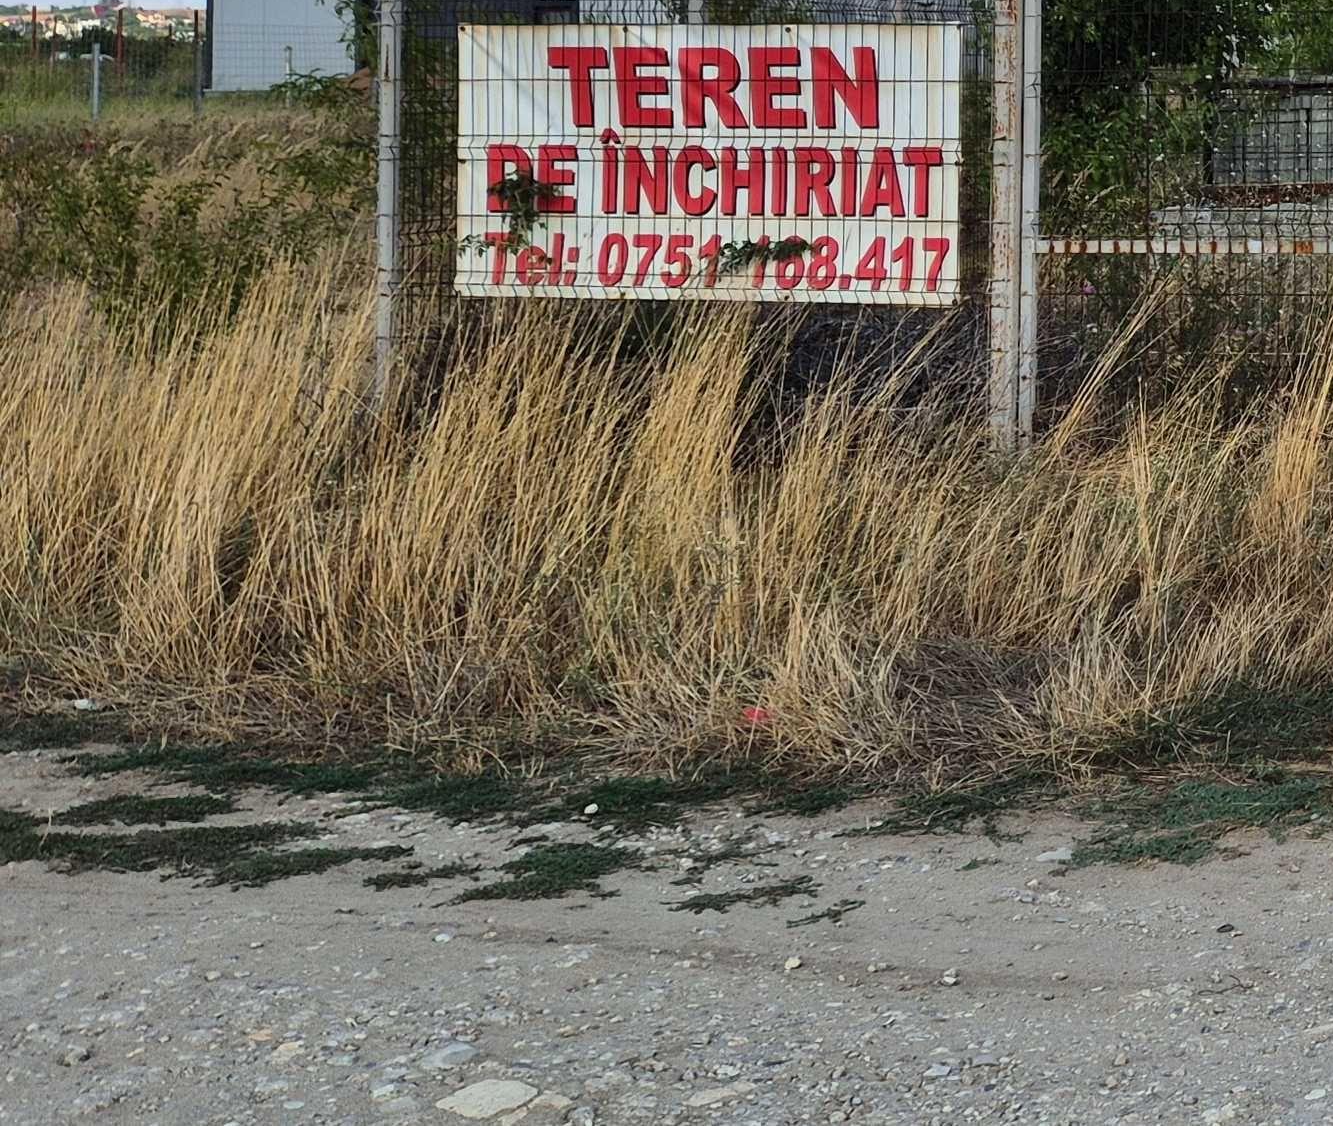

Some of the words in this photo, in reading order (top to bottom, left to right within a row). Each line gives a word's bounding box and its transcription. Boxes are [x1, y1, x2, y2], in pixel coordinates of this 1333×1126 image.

[547, 46, 878, 129] TEREN
[486, 144, 578, 215] DE
[600, 128, 943, 218] ÎNCHIRIAT
[485, 232, 580, 287] Tel:
